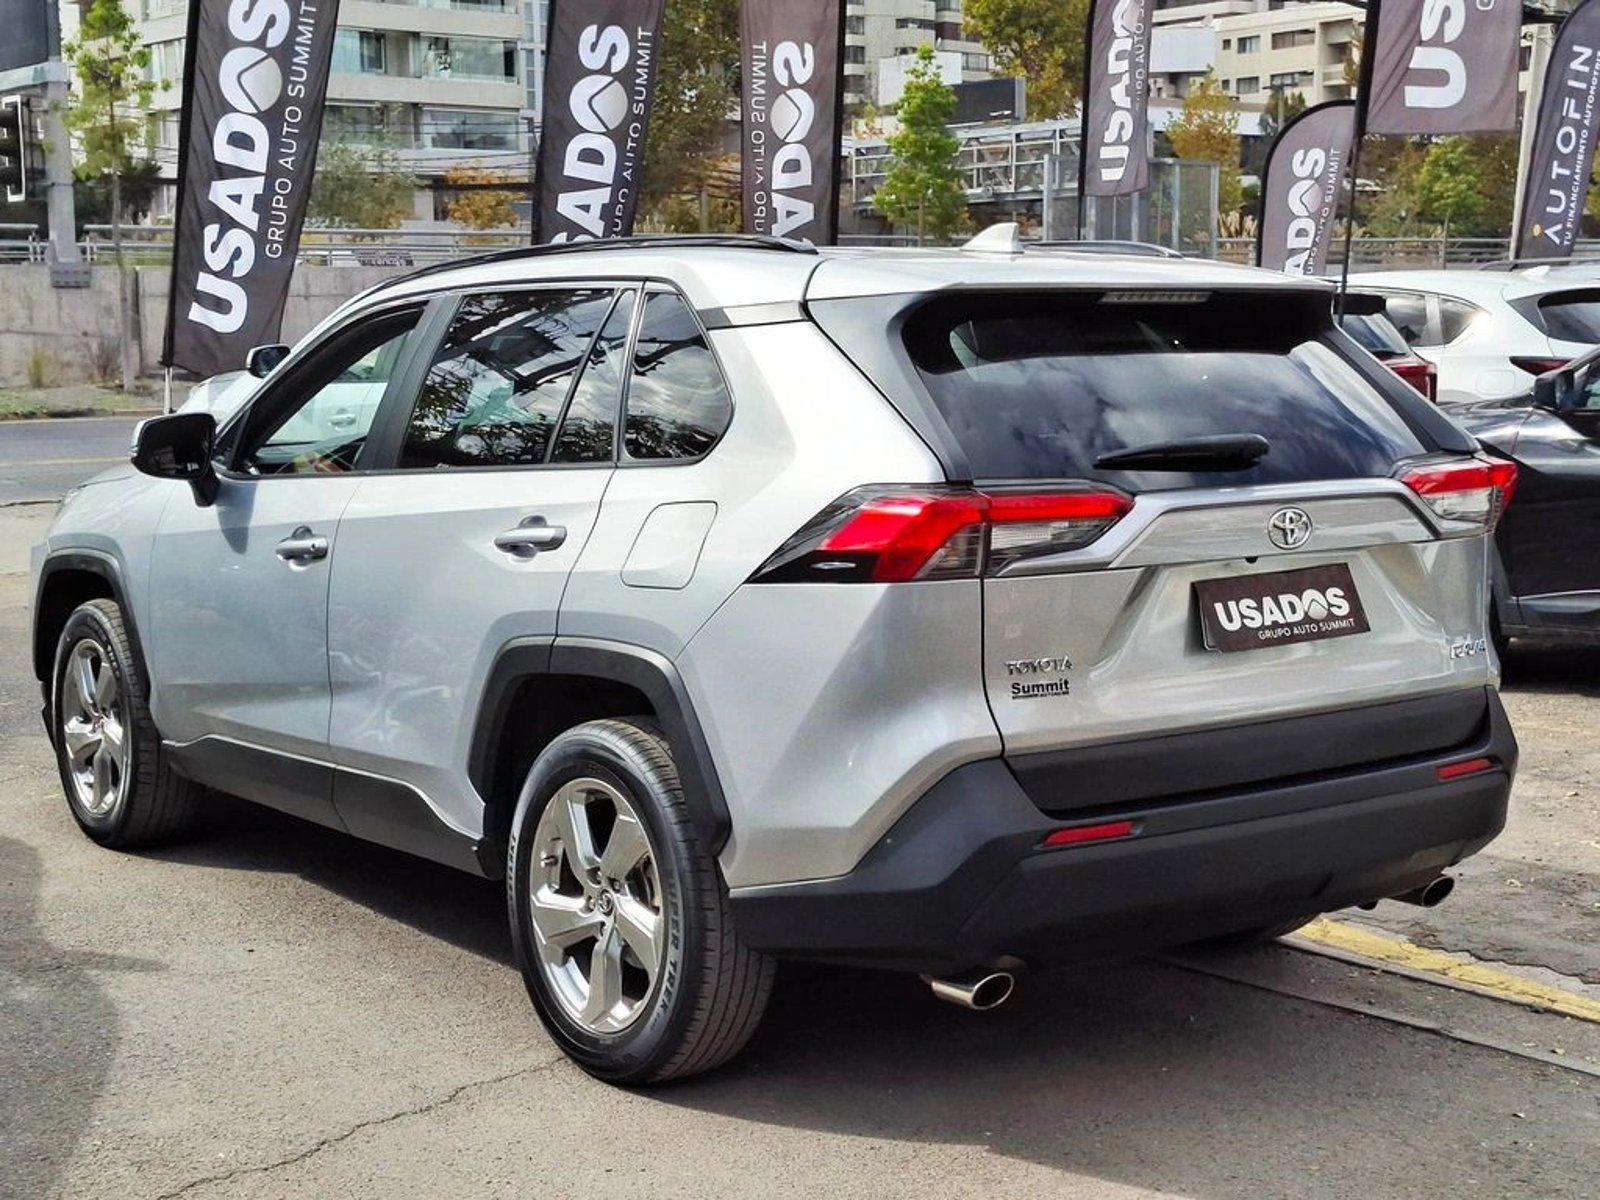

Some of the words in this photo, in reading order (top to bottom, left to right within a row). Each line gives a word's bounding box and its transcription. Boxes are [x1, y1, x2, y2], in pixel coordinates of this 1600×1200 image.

[288, 3, 317, 98] SUMMIT
[632, 26, 653, 115] SUMMIT
[1134, 23, 1145, 63] AUTO
[188, 0, 291, 333] USADOS
[277, 105, 303, 172] AUTO
[1544, 44, 1593, 245] AUTOFIN
[1324, 147, 1341, 204] SUMMIT
[1566, 129, 1588, 228] FINANCIAMIENTO
[265, 178, 293, 259] GRUPO
[1563, 232, 1573, 246] TU
[1214, 587, 1350, 631] USADOS
[1258, 627, 1291, 640] GRUPO
[1293, 623, 1318, 636] AUTO
[1319, 618, 1355, 632] SUMMIT
[1004, 657, 1073, 675] TOYOTA
[1011, 678, 1070, 695] Summit
